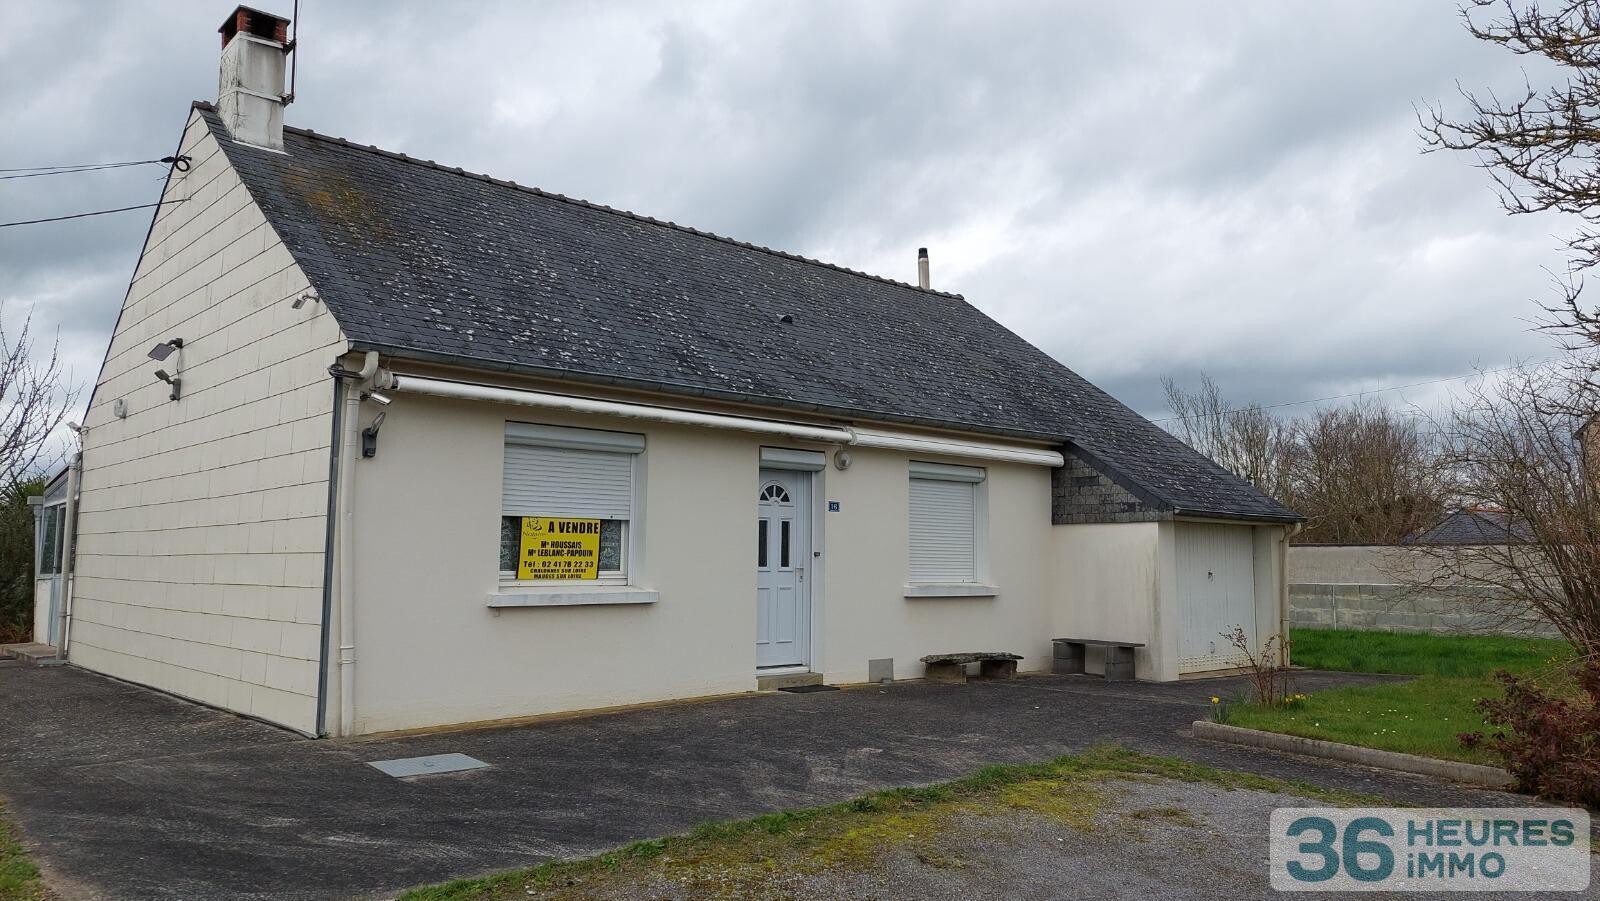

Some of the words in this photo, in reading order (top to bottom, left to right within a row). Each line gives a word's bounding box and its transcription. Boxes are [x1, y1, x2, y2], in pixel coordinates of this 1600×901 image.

[547, 520, 555, 533] A
[558, 521, 599, 534] VENDRE
[550, 541, 582, 549] HOUSSAIS
[537, 549, 593, 557] LEBLANC-PAPOUIN
